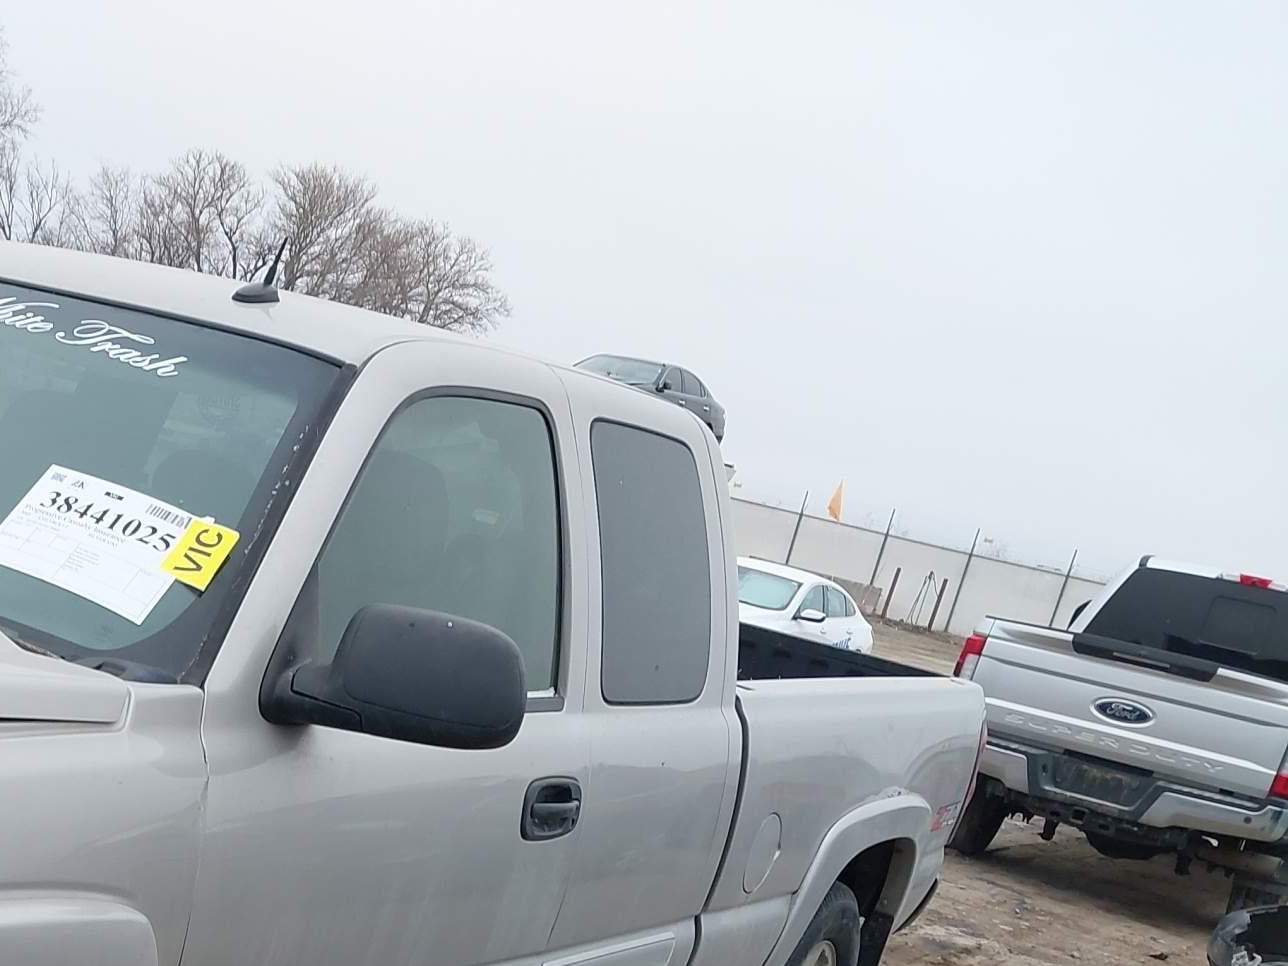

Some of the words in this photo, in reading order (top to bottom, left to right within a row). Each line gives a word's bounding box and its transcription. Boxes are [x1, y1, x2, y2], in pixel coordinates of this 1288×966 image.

[55, 319, 190, 377] Trash
[39, 490, 178, 552] 38441025
[173, 528, 224, 575] VIC
[1106, 703, 1140, 721] Ford
